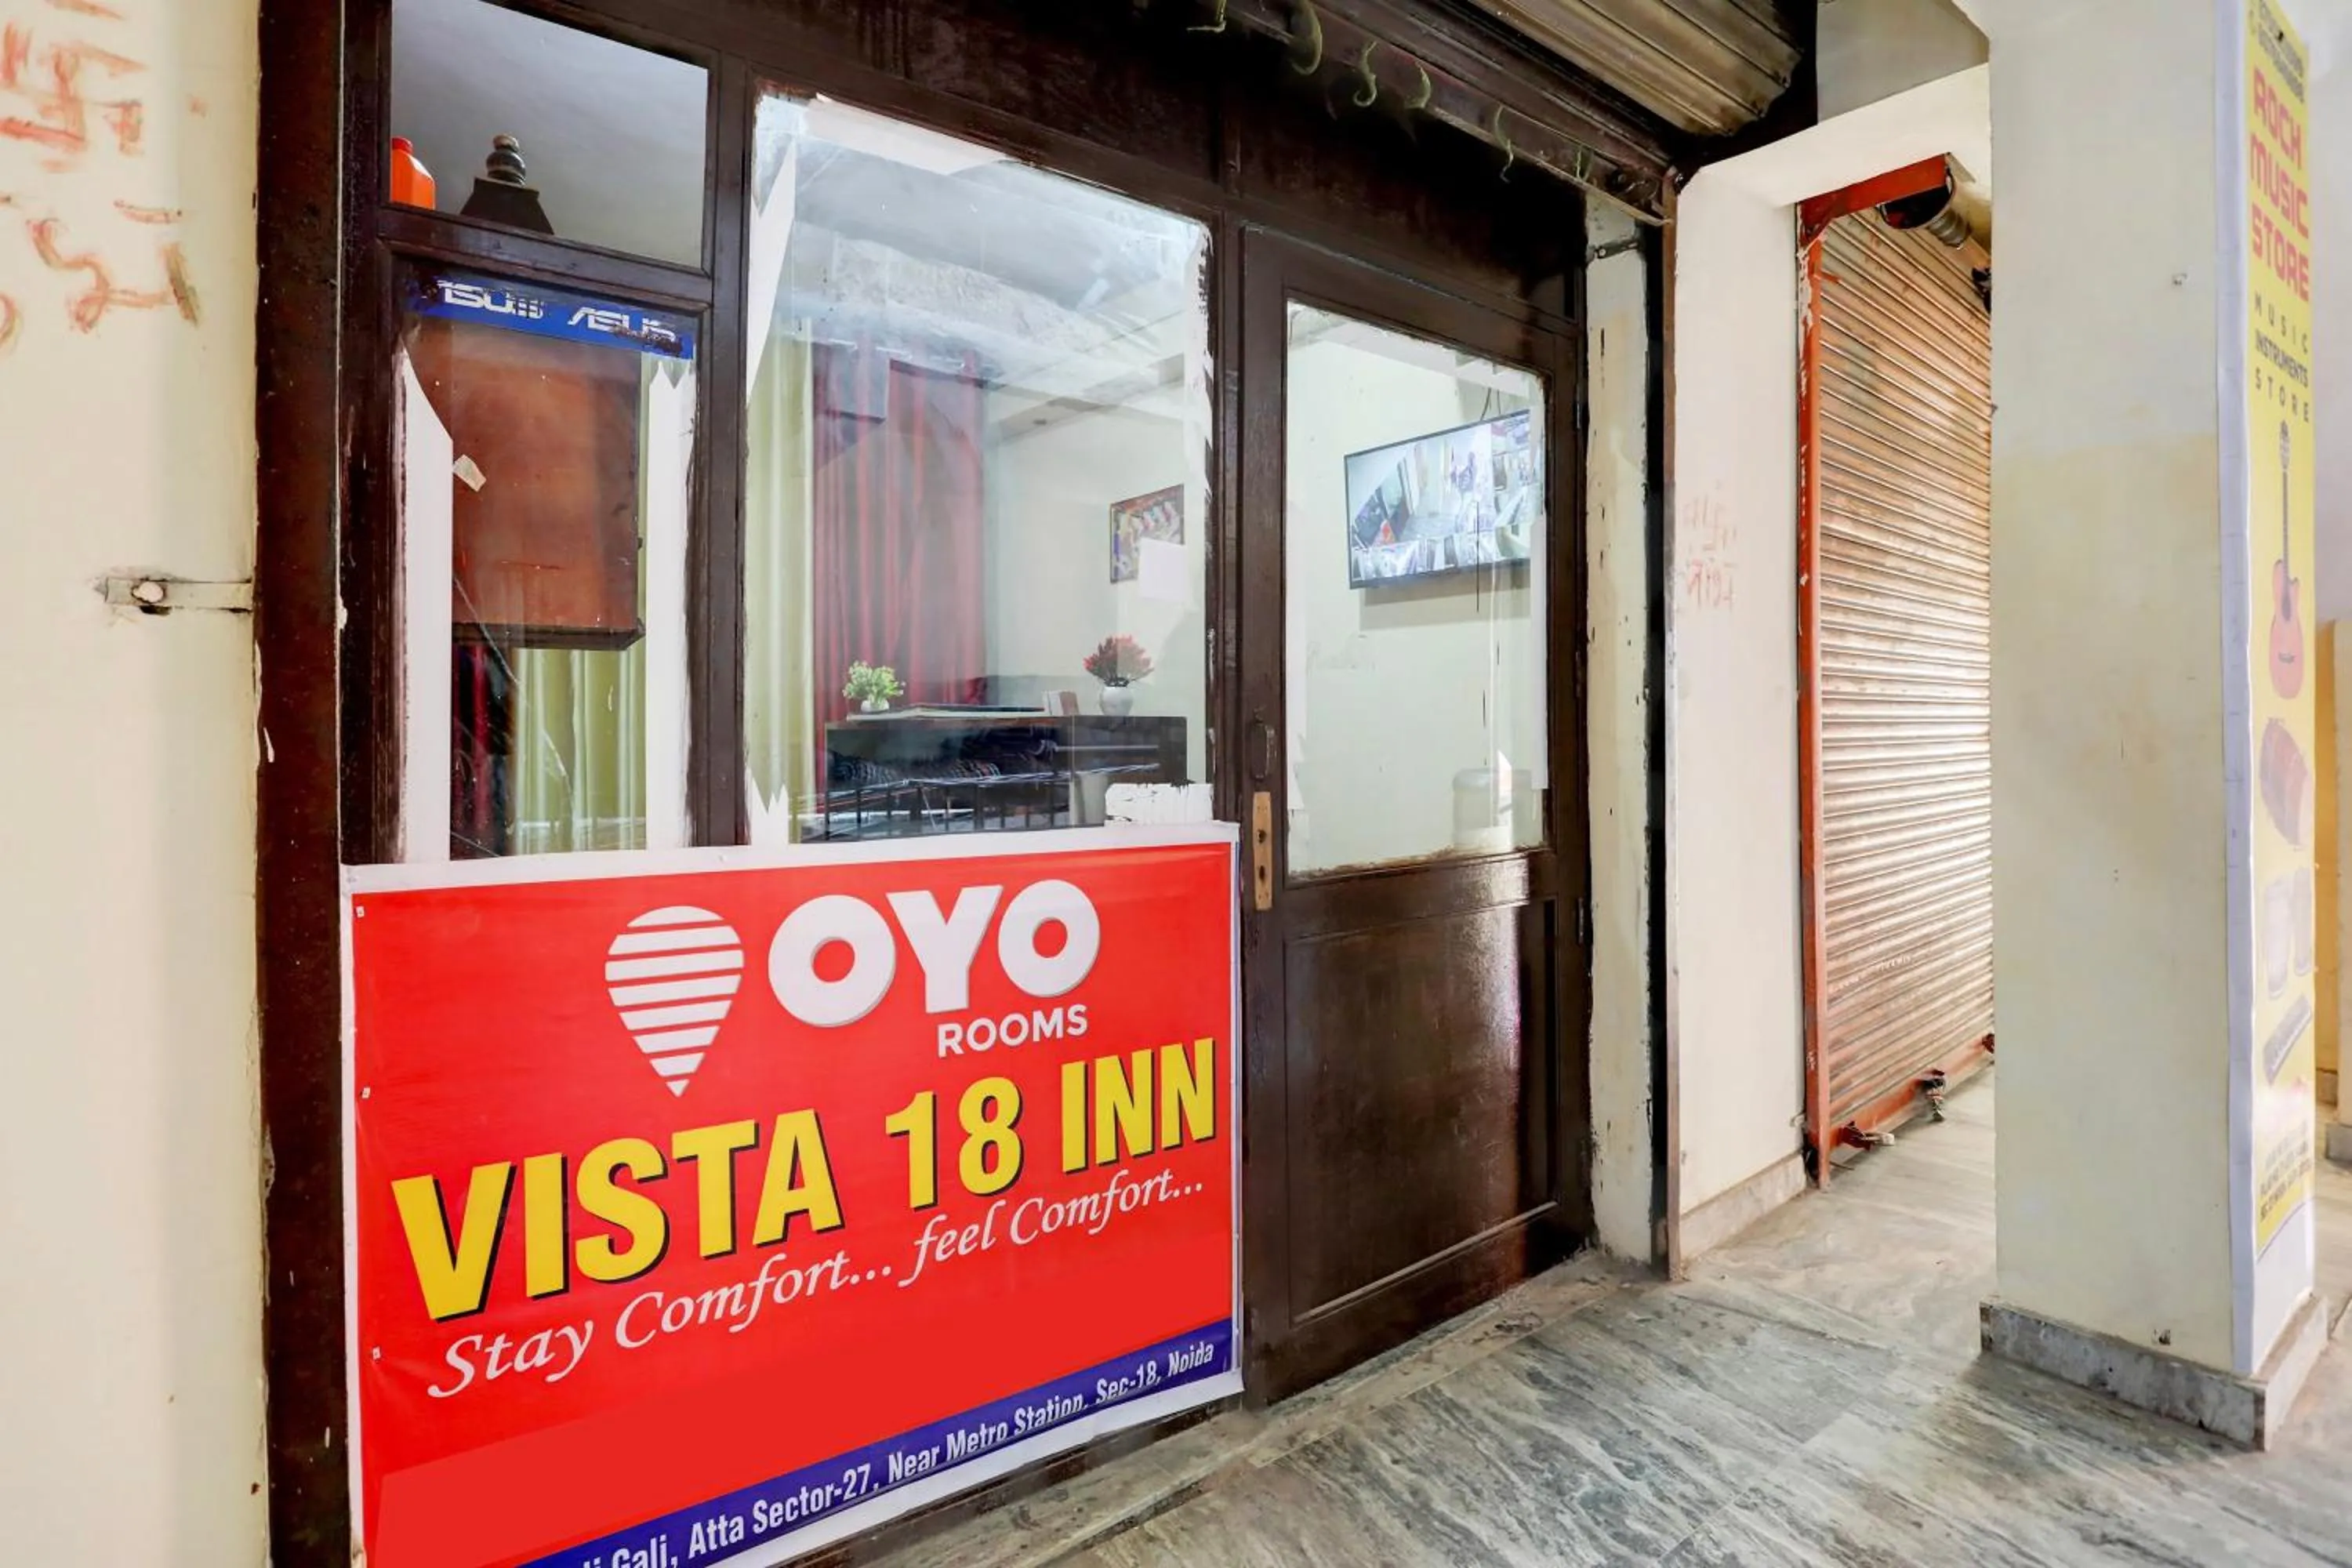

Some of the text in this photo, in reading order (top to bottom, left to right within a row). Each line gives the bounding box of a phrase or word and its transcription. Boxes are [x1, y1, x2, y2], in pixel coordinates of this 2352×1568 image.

[2250, 132, 2308, 239] MUSIC
[2252, 202, 2309, 302] STORE
[2255, 293, 2308, 355] MUSIC
[2255, 367, 2310, 424] STORE
[768, 879, 1100, 1029] OYO
[938, 1004, 1088, 1058] ROOMS
[391, 1036, 1216, 1323] VISTA 18 INN
[427, 1168, 1203, 1399] Stay Comfort... feel Comfort...
[688, 1514, 745, 1559] Atta
[888, 1444, 940, 1484] Near
[946, 1421, 1008, 1462] Metro
[1096, 1359, 1161, 1405] Sec-18,
[1167, 1340, 1214, 1377] Noida
